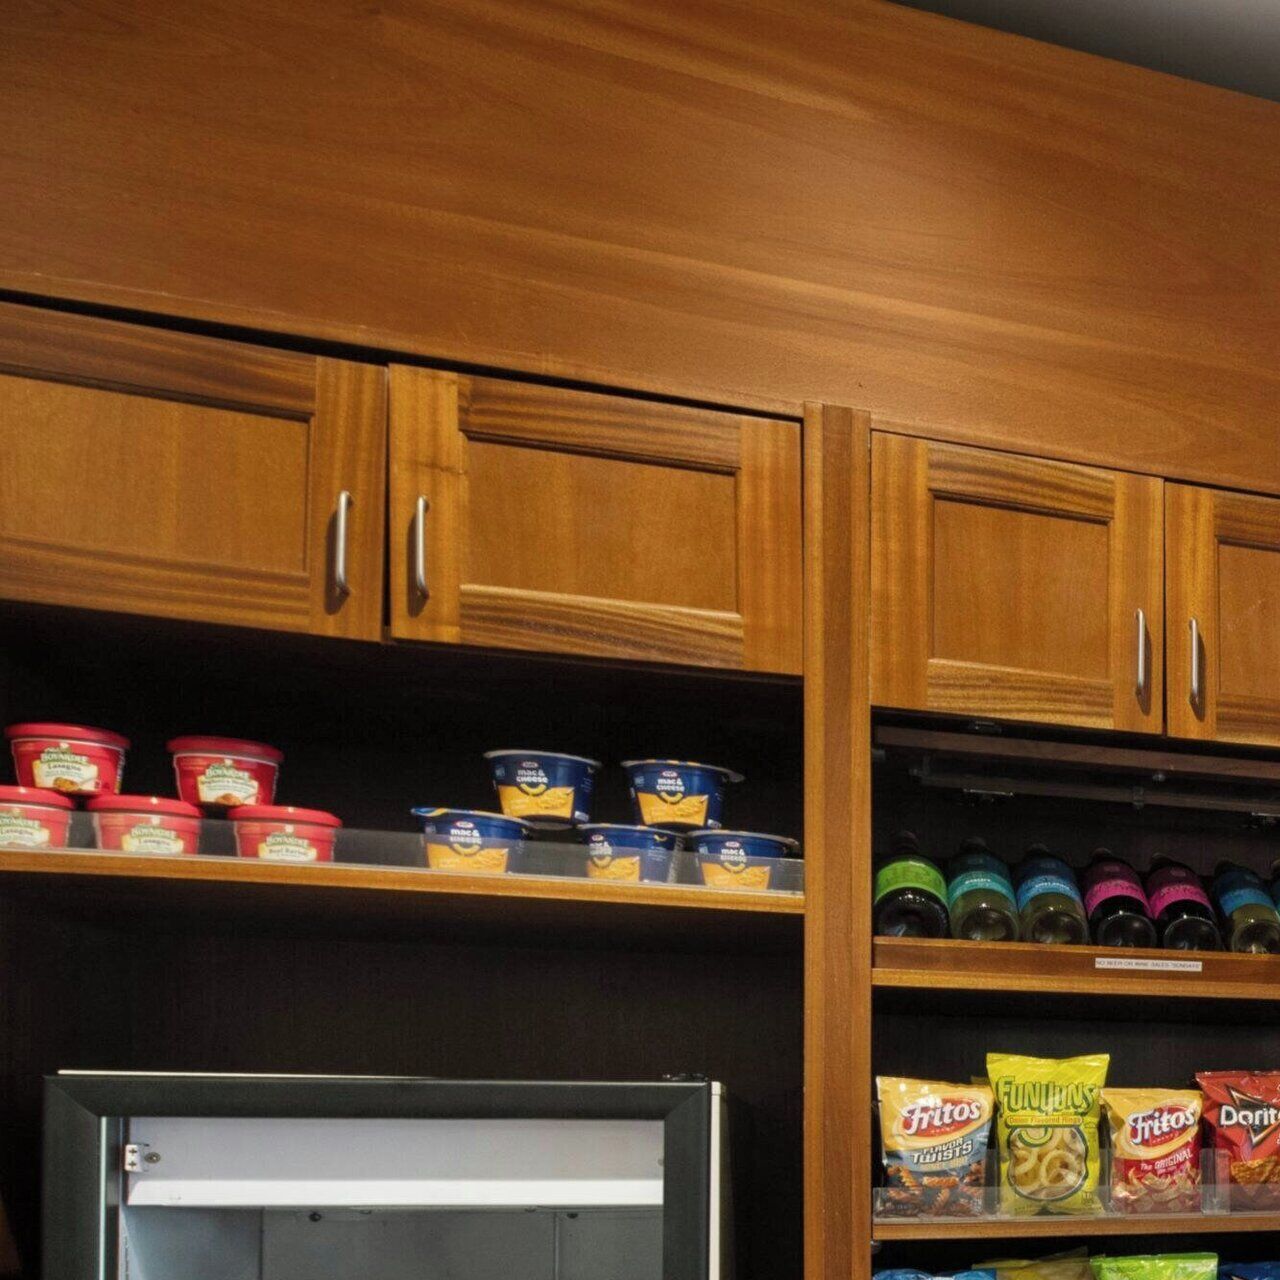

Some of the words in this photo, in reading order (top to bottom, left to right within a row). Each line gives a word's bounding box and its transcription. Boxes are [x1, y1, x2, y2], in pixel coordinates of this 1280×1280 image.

[902, 1101, 981, 1135] Fritos
[1127, 1103, 1196, 1144] Fritos
[912, 1140, 974, 1164] TWISTS
[921, 1137, 963, 1153] FLAVOR
[1154, 1149, 1194, 1170] ORIGINAL
